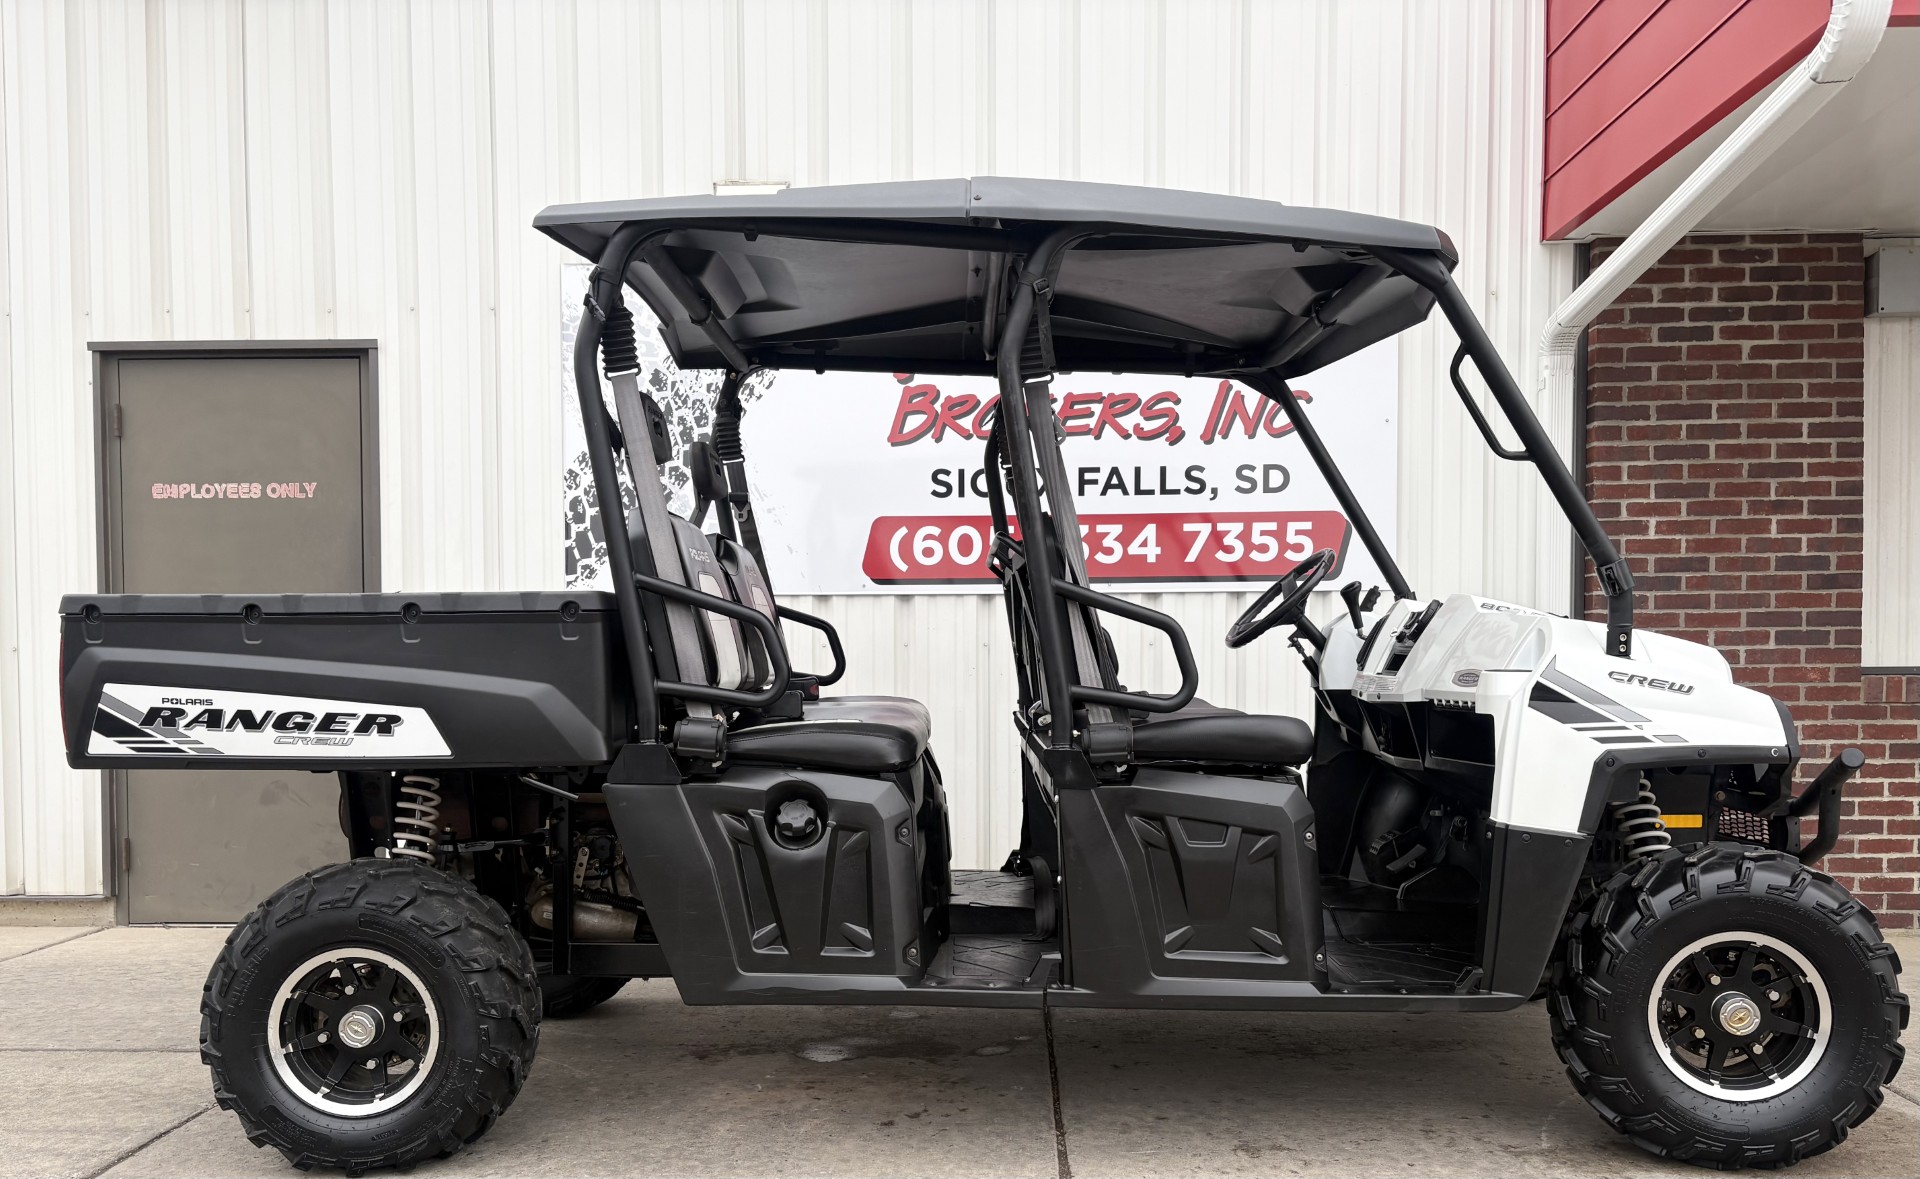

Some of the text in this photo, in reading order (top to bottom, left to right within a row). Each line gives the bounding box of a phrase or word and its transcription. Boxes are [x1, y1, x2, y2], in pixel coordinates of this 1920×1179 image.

[887, 384, 1186, 447] BROERS,
[152, 482, 318, 499] EMPLOYEES ONLY
[1078, 465, 1218, 501] FALLS,
[1234, 464, 1291, 494] SD
[1182, 521, 1315, 563] 7355
[1607, 670, 1696, 696] CREW
[161, 697, 214, 706] POLARIS
[138, 706, 405, 737] RANGER
[273, 735, 355, 746] CREW
